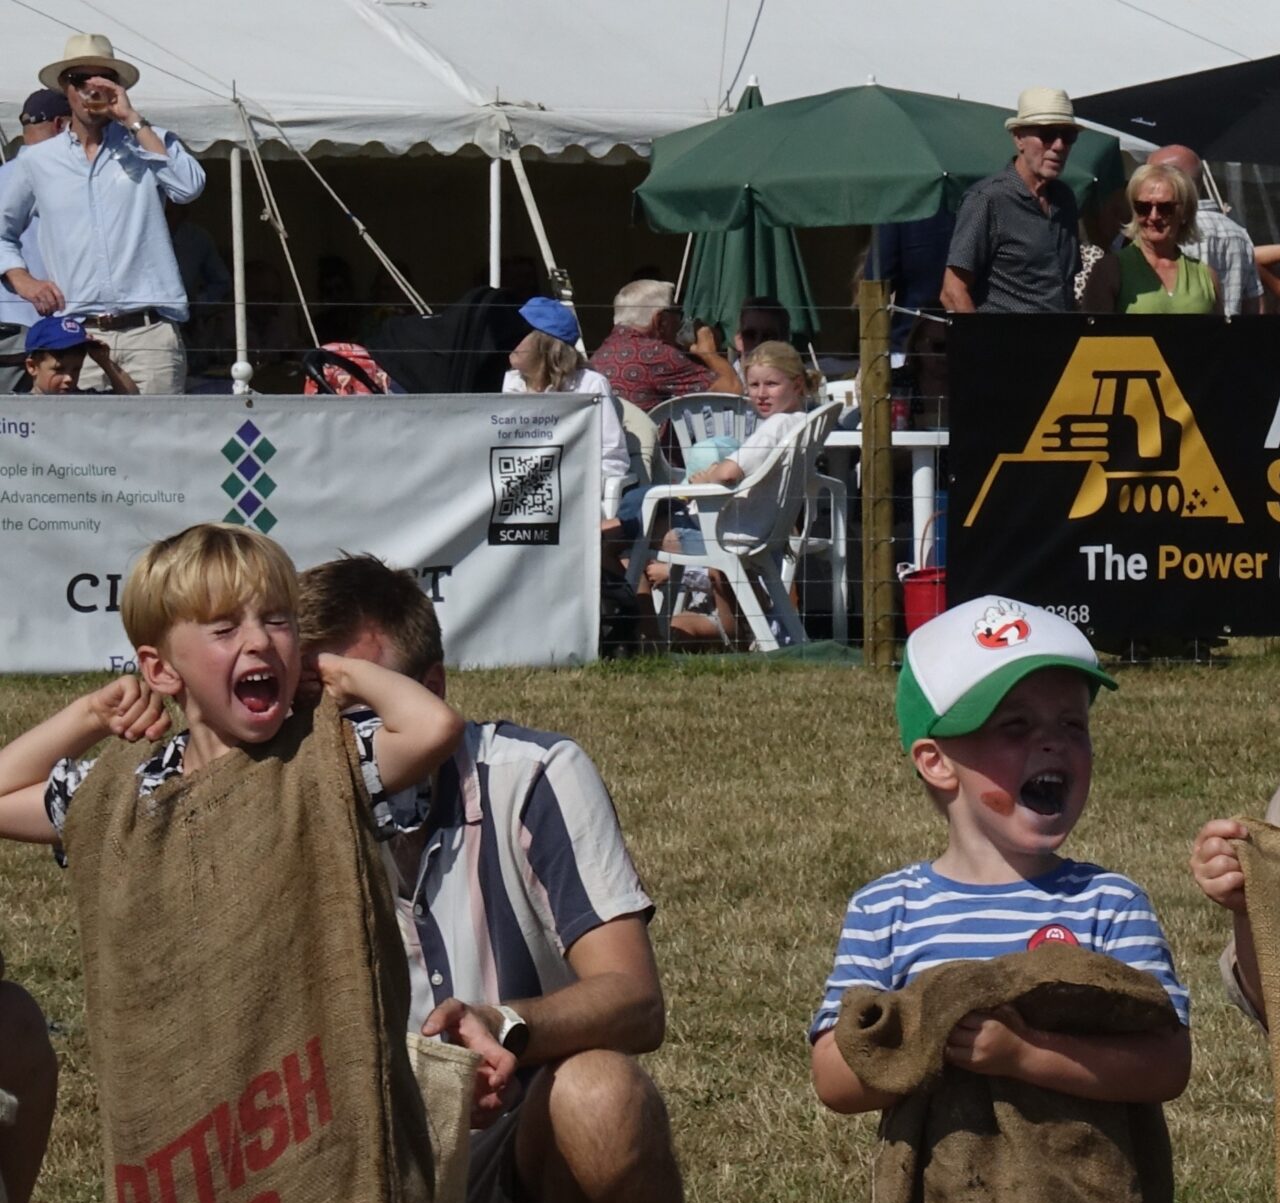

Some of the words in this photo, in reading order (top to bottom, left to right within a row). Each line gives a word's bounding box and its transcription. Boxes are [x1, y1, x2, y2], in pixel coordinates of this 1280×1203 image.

[490, 415, 517, 425] Scan
[520, 415, 530, 425] to
[532, 414, 560, 425] apply
[0, 418, 36, 438] ing:
[498, 430, 512, 440] for
[514, 429, 554, 441] funding
[32, 464, 44, 476] in
[47, 464, 117, 479] Agriculture
[1, 491, 97, 503] Advancements
[102, 491, 113, 503] in
[116, 491, 185, 506] Agriculture
[2, 518, 23, 530] the
[28, 518, 101, 534] Community
[500, 530, 532, 541] SCAN
[534, 530, 550, 541] ME
[1079, 543, 1147, 581] The
[1158, 545, 1268, 580] Power
